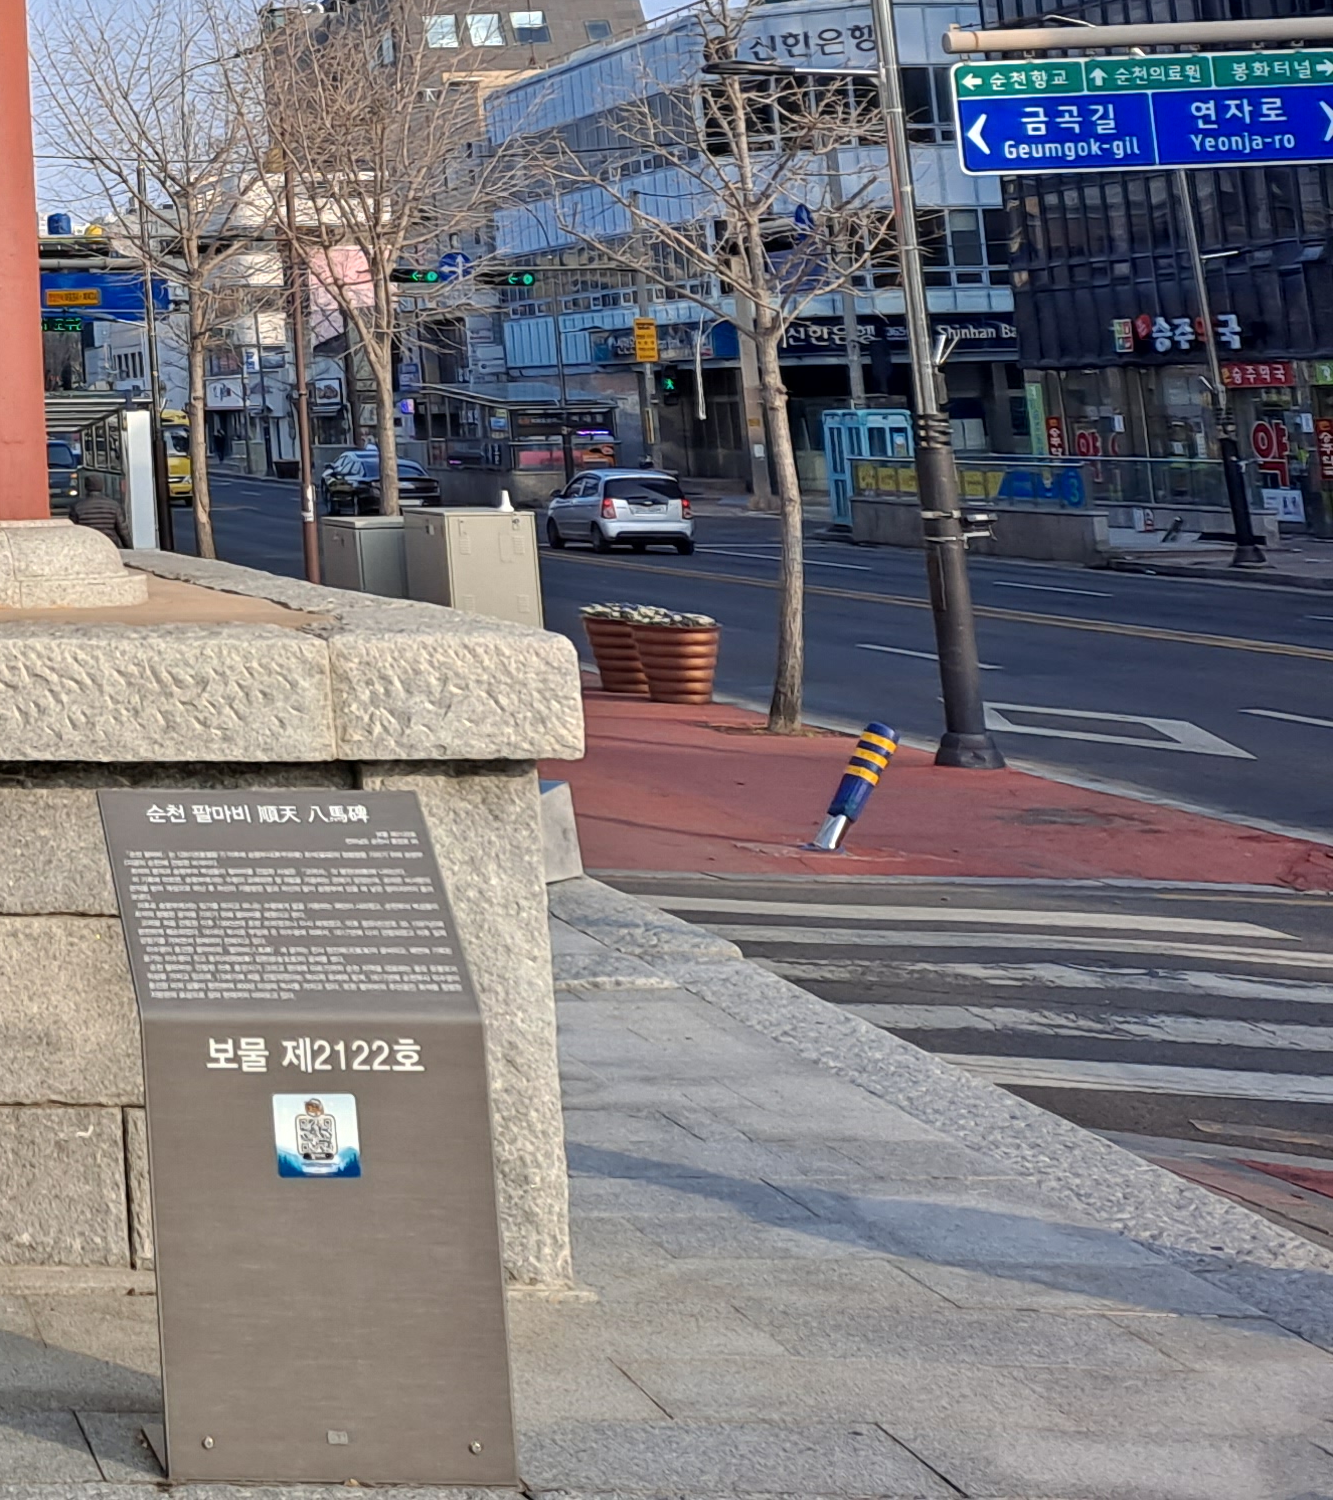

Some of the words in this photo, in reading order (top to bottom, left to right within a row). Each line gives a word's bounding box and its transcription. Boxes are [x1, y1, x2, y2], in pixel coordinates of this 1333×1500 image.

[749, 24, 876, 61] 신한은행
[989, 70, 1069, 91] 순천향교
[1114, 64, 1202, 86] 순천의료원
[1231, 59, 1312, 82] 봉화터널
[1021, 104, 1117, 135] 금곡길
[1191, 98, 1287, 129] 연자로
[1004, 136, 1141, 161] Geumgok-gil
[1190, 132, 1295, 153] Yeonja-ro
[936, 324, 997, 339] Shinhan
[145, 804, 187, 824] 순천
[191, 804, 252, 824] 팔마비
[308, 804, 371, 824] 八馬碑
[206, 1037, 270, 1073] 보물
[281, 1037, 426, 1074] 제2122호
